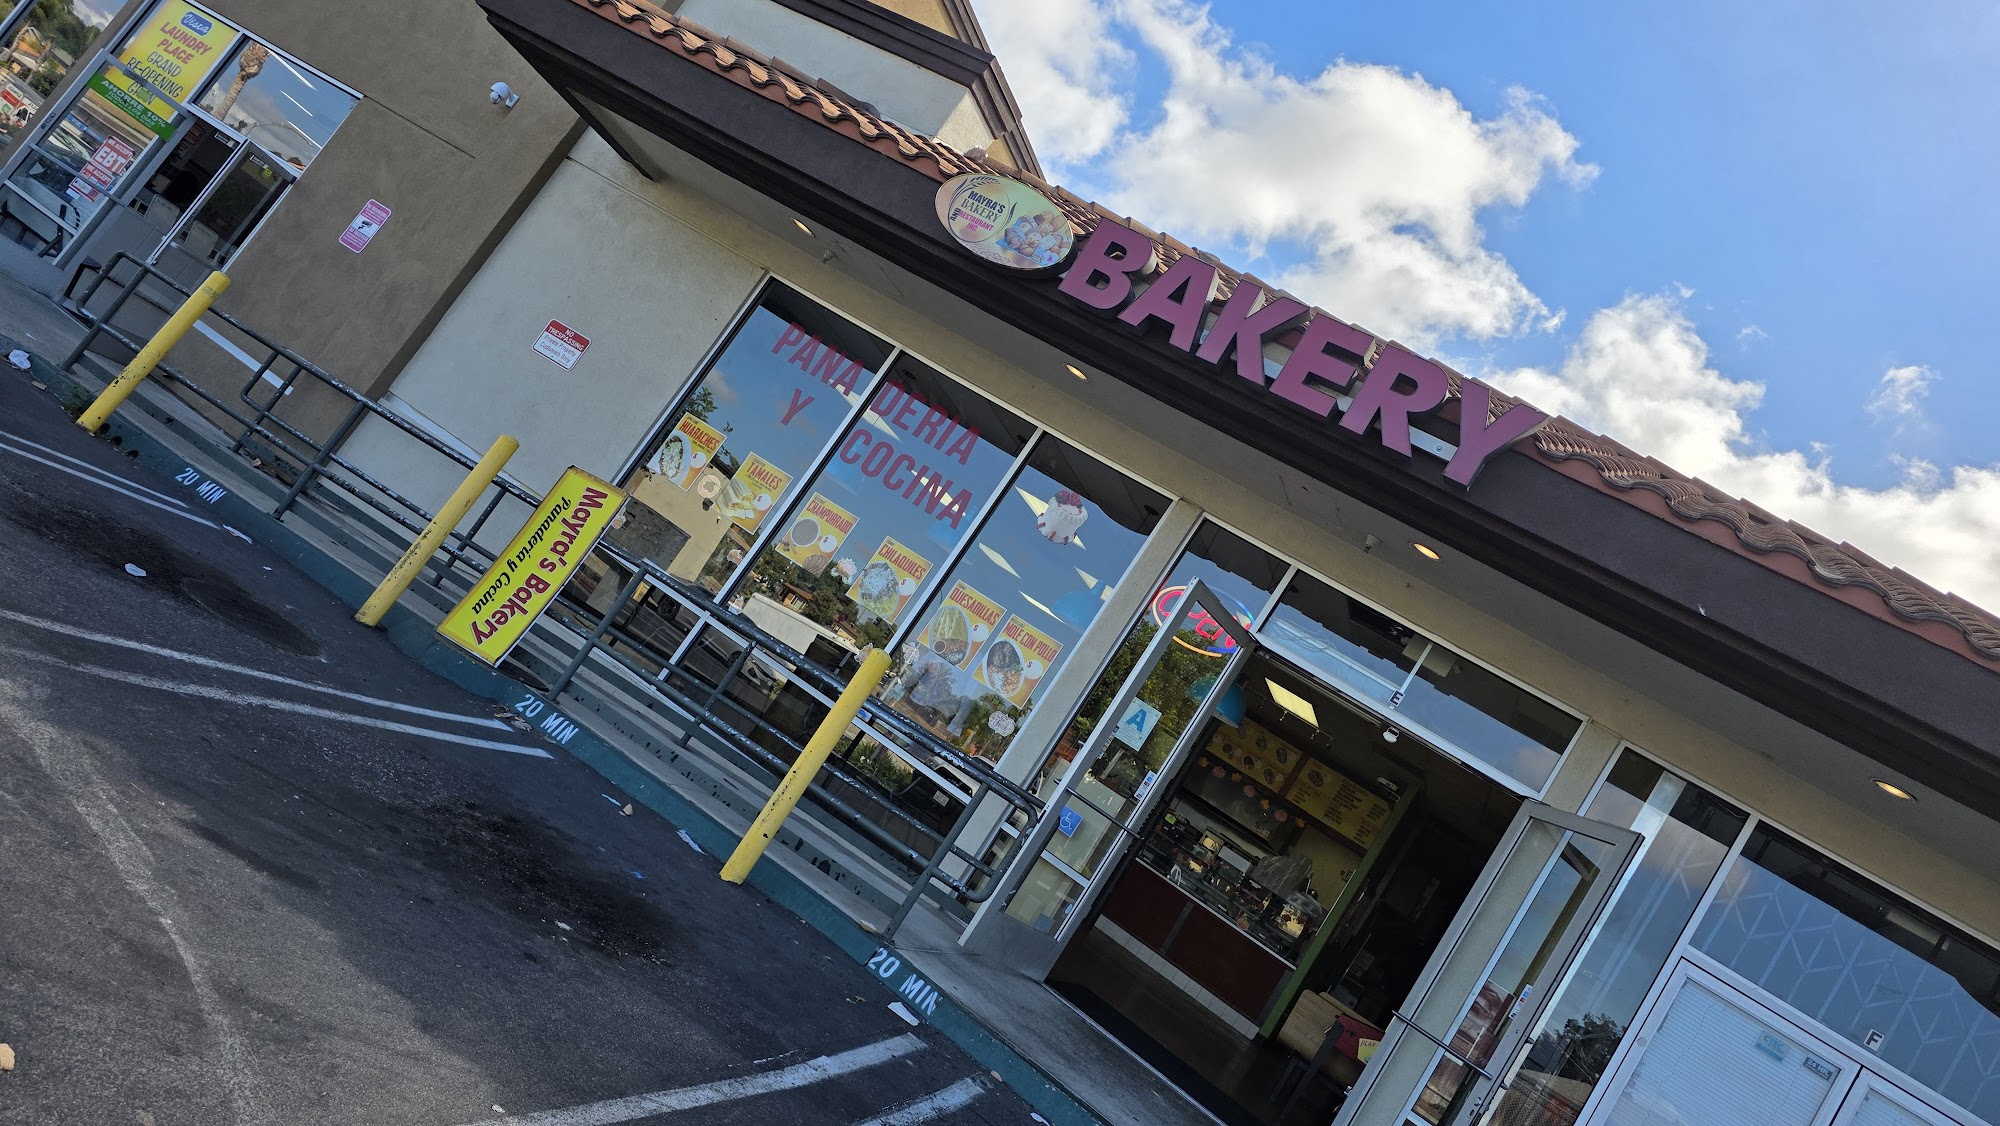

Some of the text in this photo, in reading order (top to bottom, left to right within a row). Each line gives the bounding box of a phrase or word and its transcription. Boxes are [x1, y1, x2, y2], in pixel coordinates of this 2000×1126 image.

[185, 13, 210, 33] Vista
[157, 38, 195, 64] PLACE
[160, 22, 213, 56] LAUNDRY
[126, 56, 184, 98] RE-OPENING
[147, 51, 182, 77] GRAND
[101, 79, 145, 112] AHORRE
[147, 111, 166, 128] 10%
[95, 146, 127, 173] EBT
[107, 137, 134, 158] WE ACCEPT
[86, 163, 110, 183] WE ACCEPT
[950, 208, 961, 222] AND
[961, 198, 1001, 223] BAKERY
[968, 190, 1005, 214] MAYRA'S
[959, 211, 995, 232] RESTAURANT
[548, 326, 585, 351] TRESPASSING
[565, 329, 575, 338] NO
[1057, 217, 1548, 489] BAKERY
[679, 420, 720, 451] HUARACHES
[780, 388, 973, 530] Y COCINA
[175, 467, 227, 504] 20 MIN
[746, 461, 783, 490] TAMALES
[806, 500, 854, 534] CHAMPURRADO
[469, 487, 609, 645] Mayra's Bakery
[506, 559, 518, 573] y
[878, 544, 926, 580] CHILAQUILES
[472, 571, 511, 614] Cocina
[949, 587, 1001, 626] QUESADILLAS
[1002, 621, 1024, 641] MOLE
[1019, 632, 1037, 650] CON
[1032, 640, 1057, 662] POLLO
[1390, 690, 1404, 705] E
[515, 694, 579, 744] 20 MIN
[1125, 708, 1147, 732] A
[868, 947, 939, 1016] 20 MIN
[1865, 1032, 1883, 1046] F
[1806, 1060, 1817, 1069] 24
